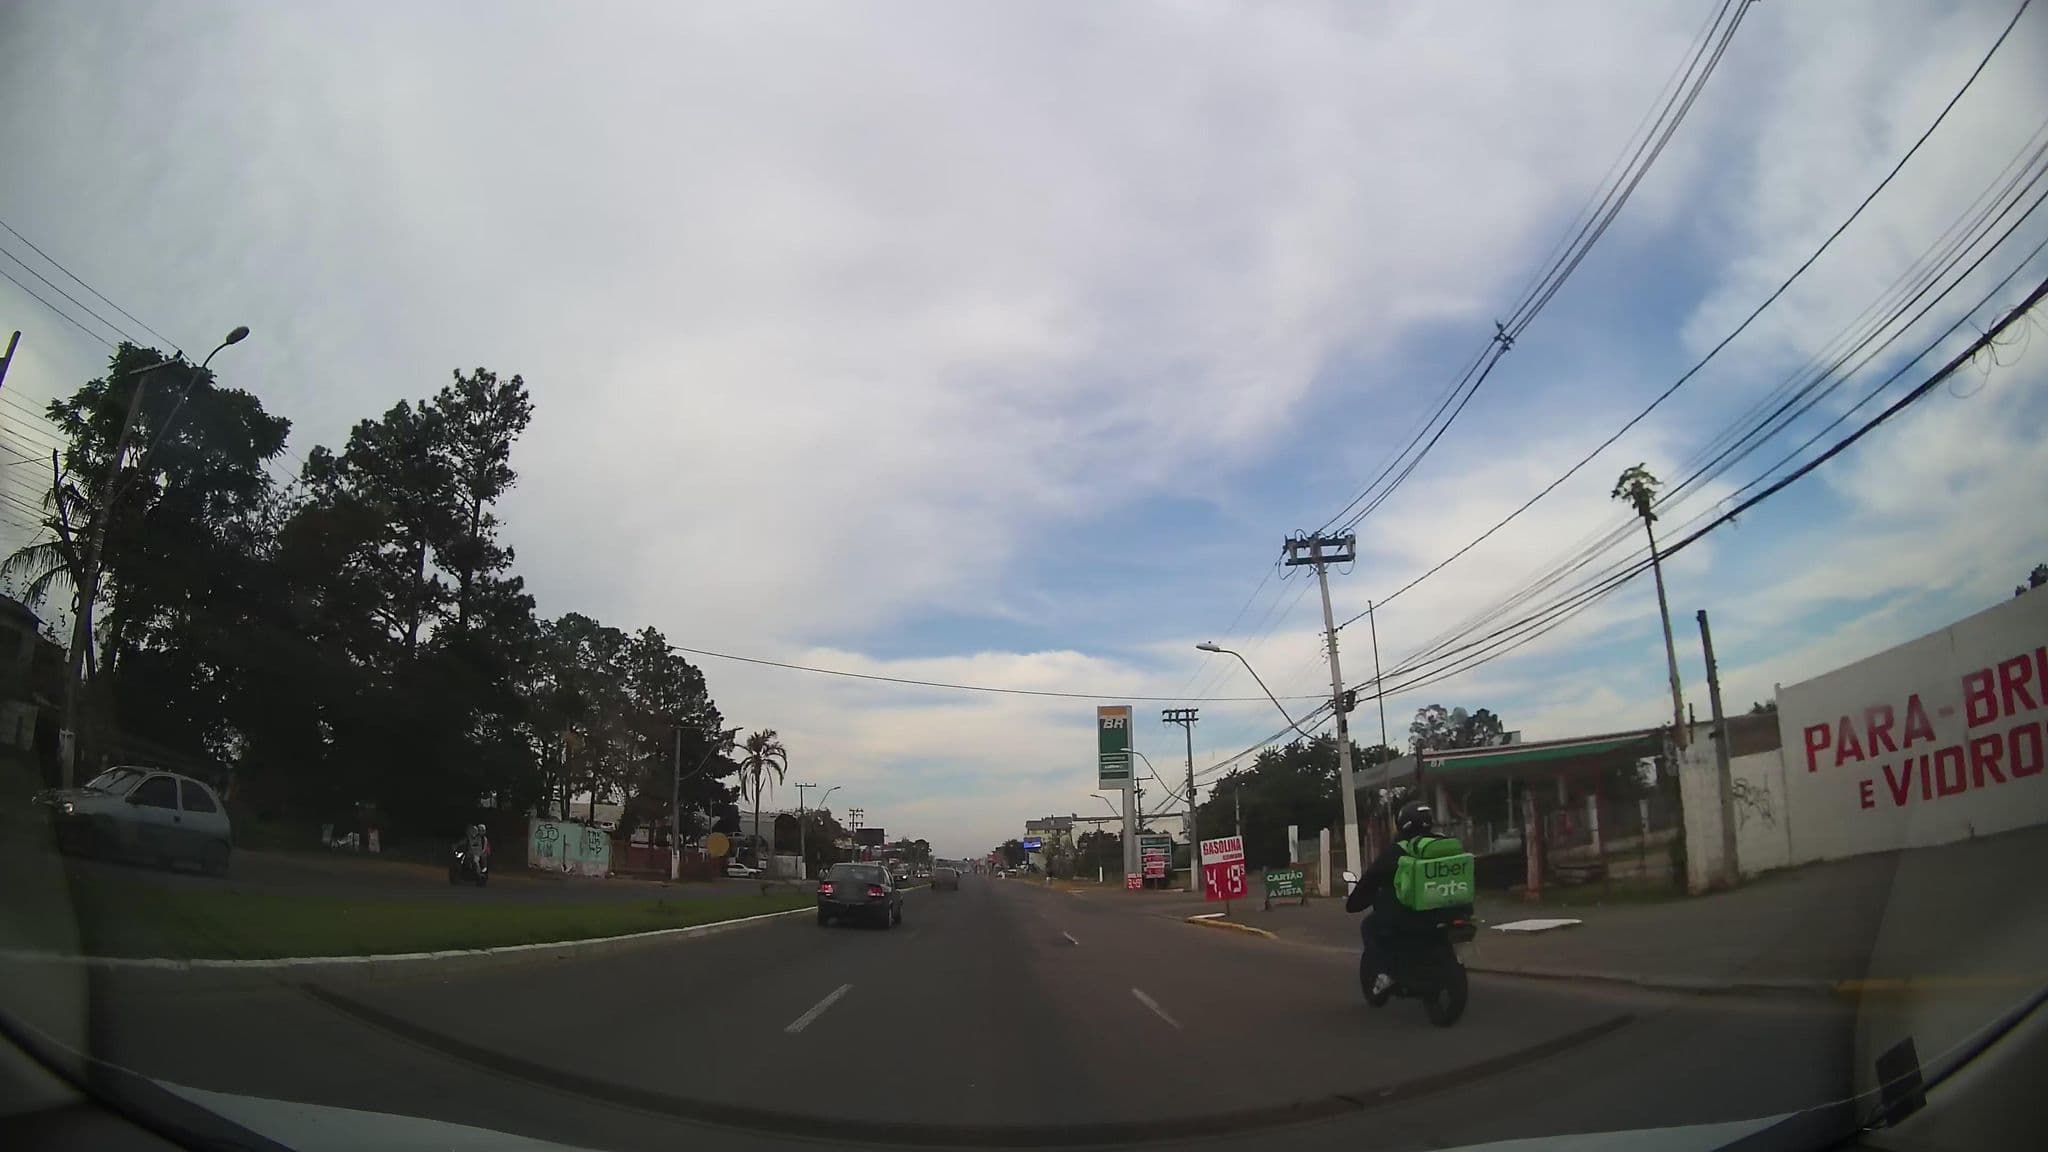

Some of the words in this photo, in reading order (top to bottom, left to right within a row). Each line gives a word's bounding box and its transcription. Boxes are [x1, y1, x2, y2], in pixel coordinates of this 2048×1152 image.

[1103, 718, 1125, 729] BR
[1859, 780, 1875, 809] E
[1882, 722, 2048, 807] VIDRO
[1203, 838, 1241, 855] GASOLINA
[1424, 861, 1467, 879] Uber
[1424, 880, 1467, 896] Eats
